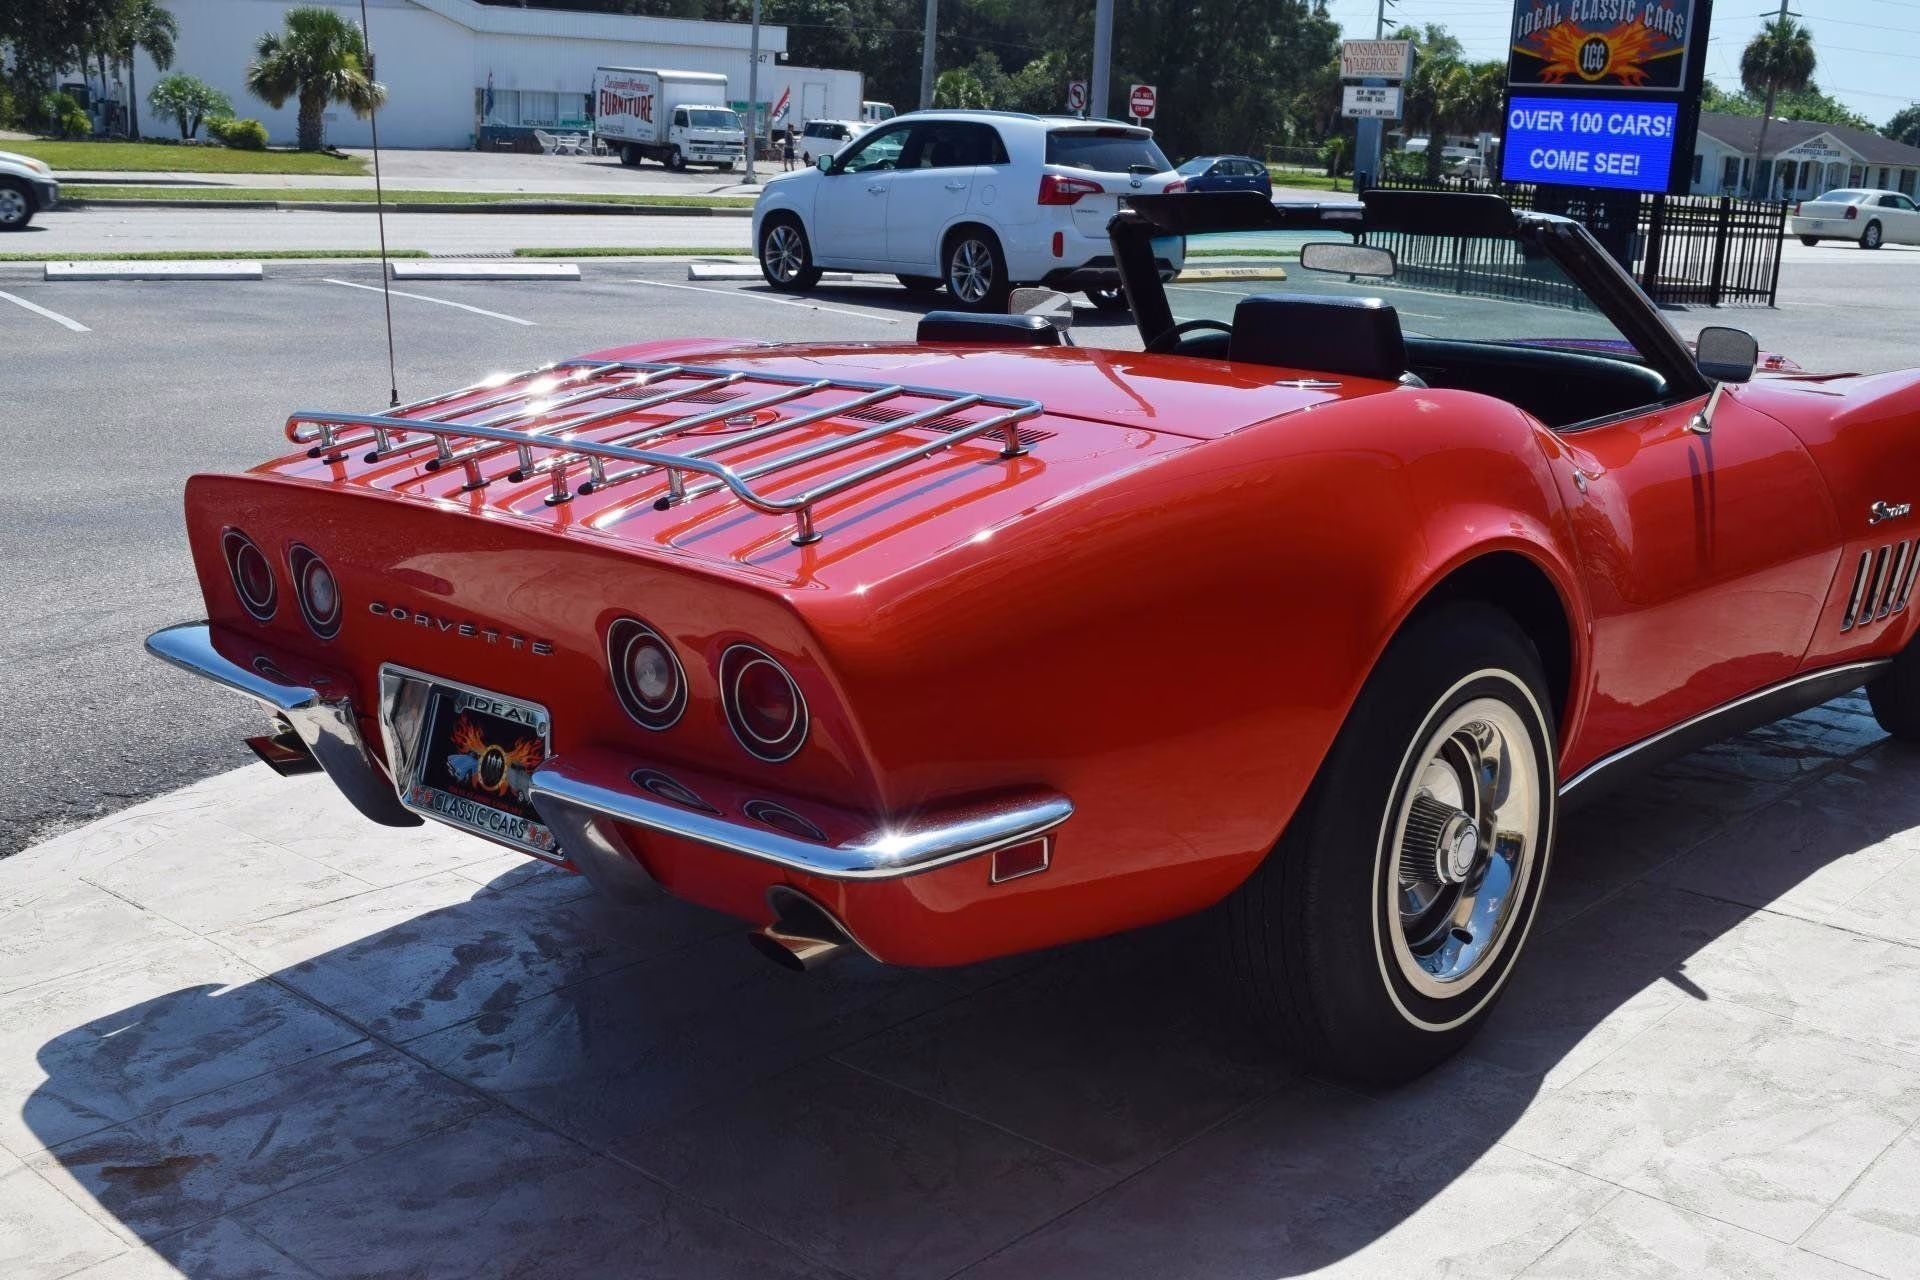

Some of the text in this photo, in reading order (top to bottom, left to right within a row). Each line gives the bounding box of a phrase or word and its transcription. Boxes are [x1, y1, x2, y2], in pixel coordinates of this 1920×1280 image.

[1517, 0, 1684, 39] IDEAL CLASSIC CARS
[1344, 42, 1406, 57] CONSIGNMENT
[1583, 41, 1605, 71] ICC
[1344, 57, 1399, 74] WAREHOUSE
[600, 88, 654, 124] FURNITURE
[1510, 109, 1672, 137] OVER 100 CARS!
[1530, 148, 1640, 176] COME SEE!
[368, 602, 554, 657] CORVETTE
[467, 696, 535, 724] IDEAL
[433, 793, 486, 826] CLASSIC
[489, 813, 526, 839] CARS
